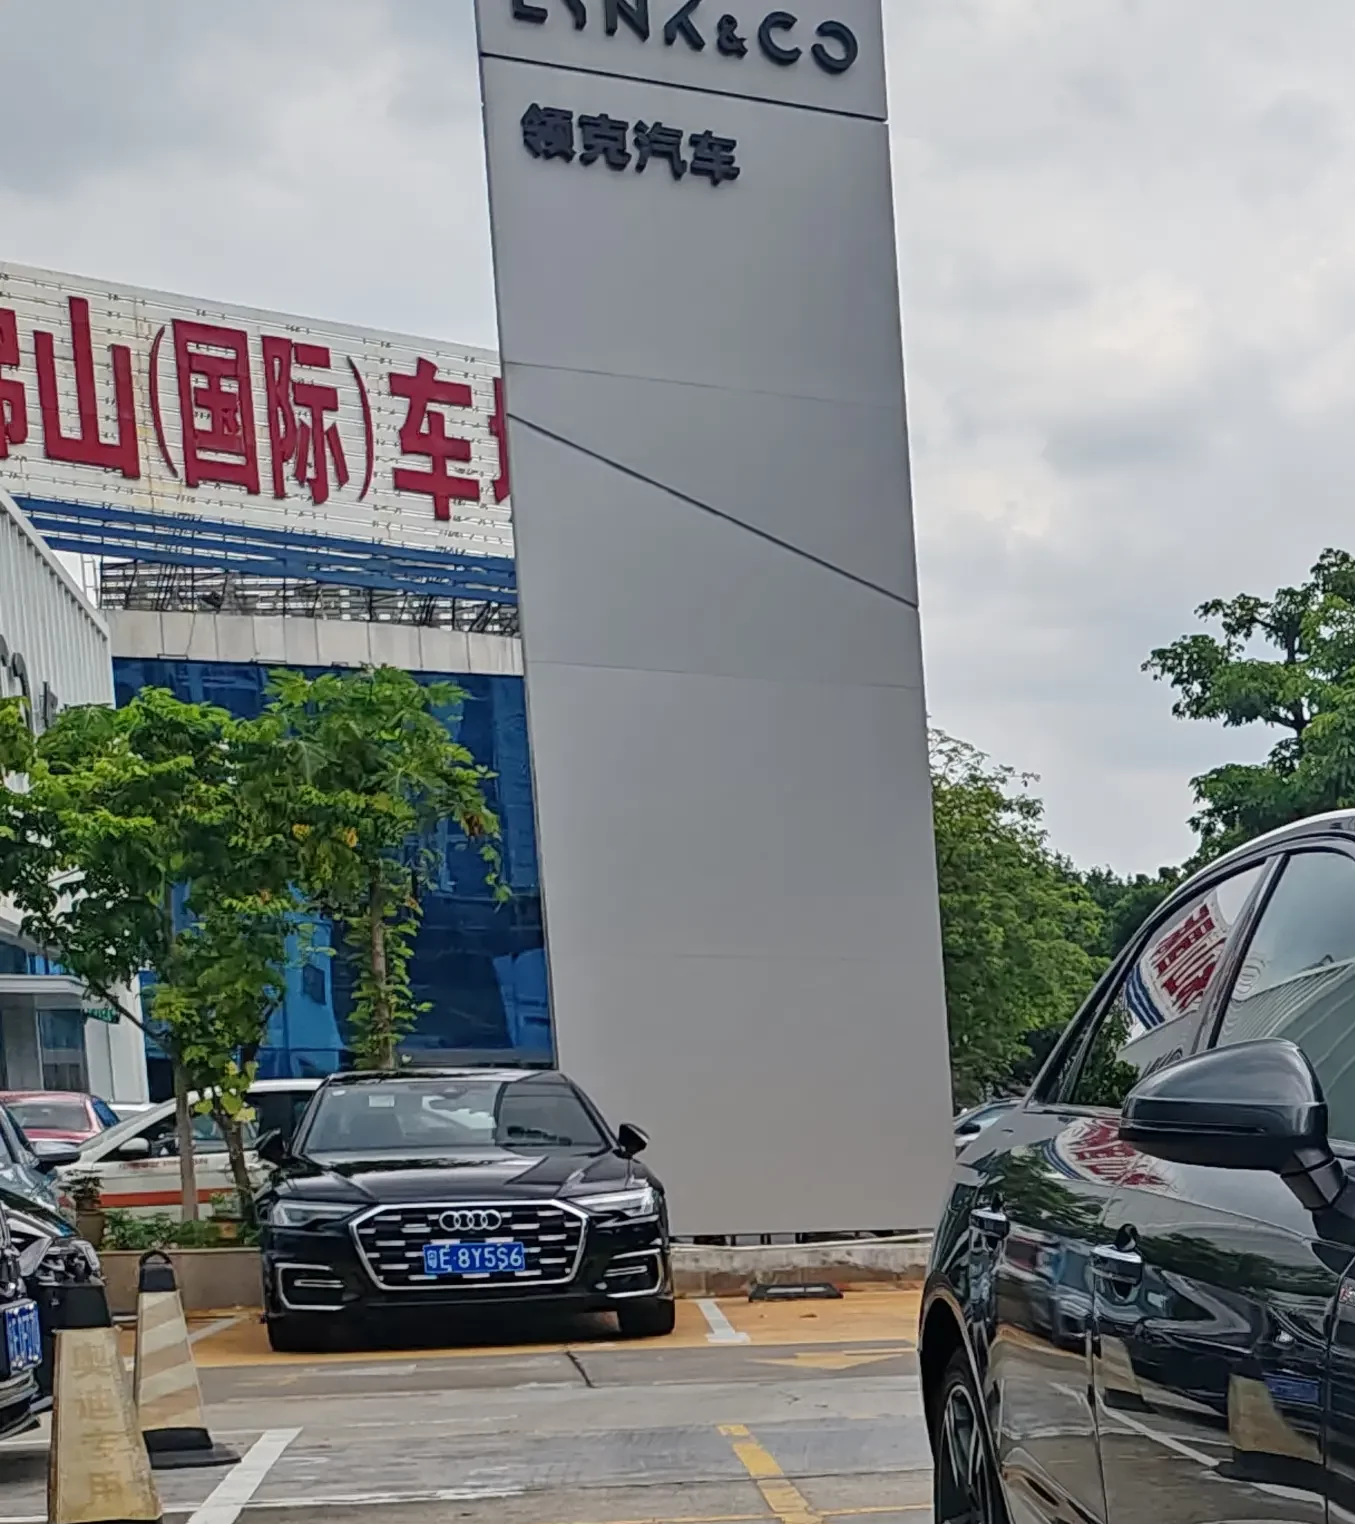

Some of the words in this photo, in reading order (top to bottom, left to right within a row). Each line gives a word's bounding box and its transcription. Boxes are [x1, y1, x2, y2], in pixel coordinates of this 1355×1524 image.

[521, 103, 740, 187] 领克汽车
[0, 296, 511, 521] 山(国际)车
